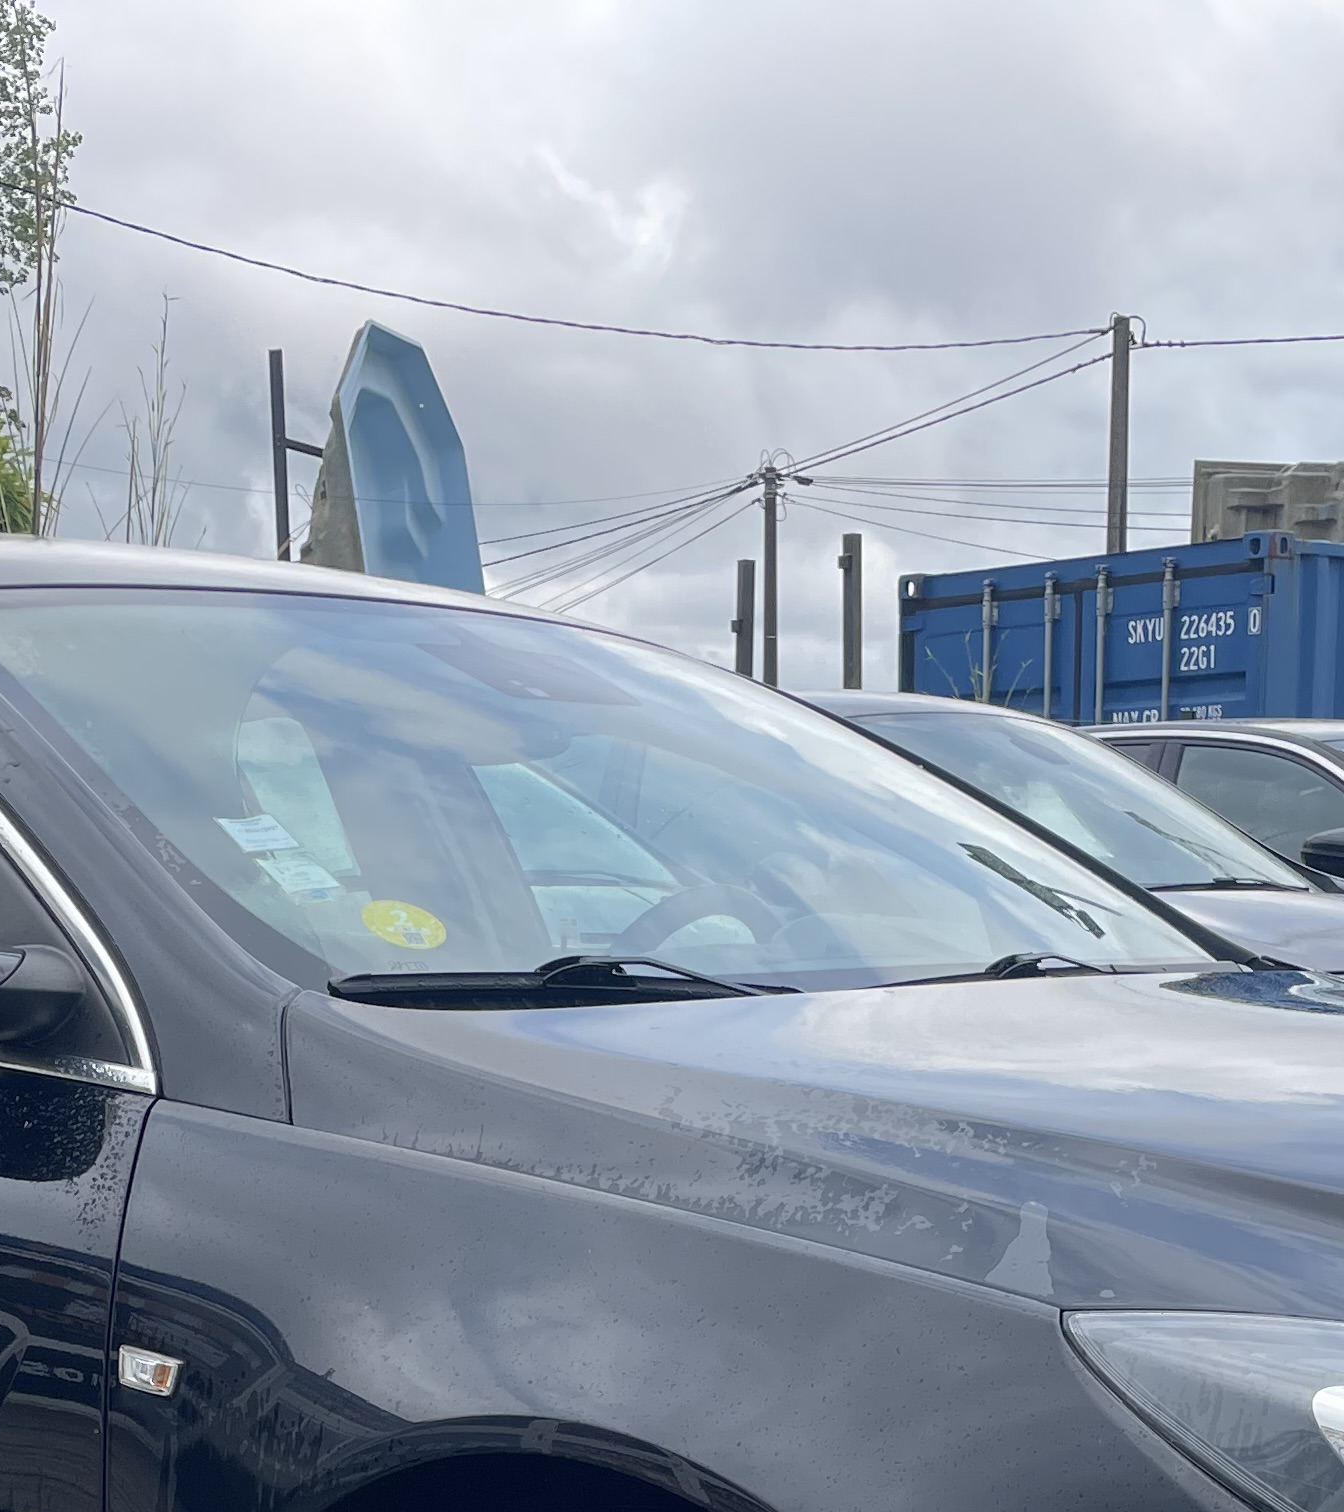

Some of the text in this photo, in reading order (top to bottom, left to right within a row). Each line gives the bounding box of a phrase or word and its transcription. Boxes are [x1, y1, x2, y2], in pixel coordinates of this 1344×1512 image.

[1128, 617, 1164, 644] SKYU
[1180, 611, 1235, 639] 226435
[1180, 645, 1215, 671] 22G1
